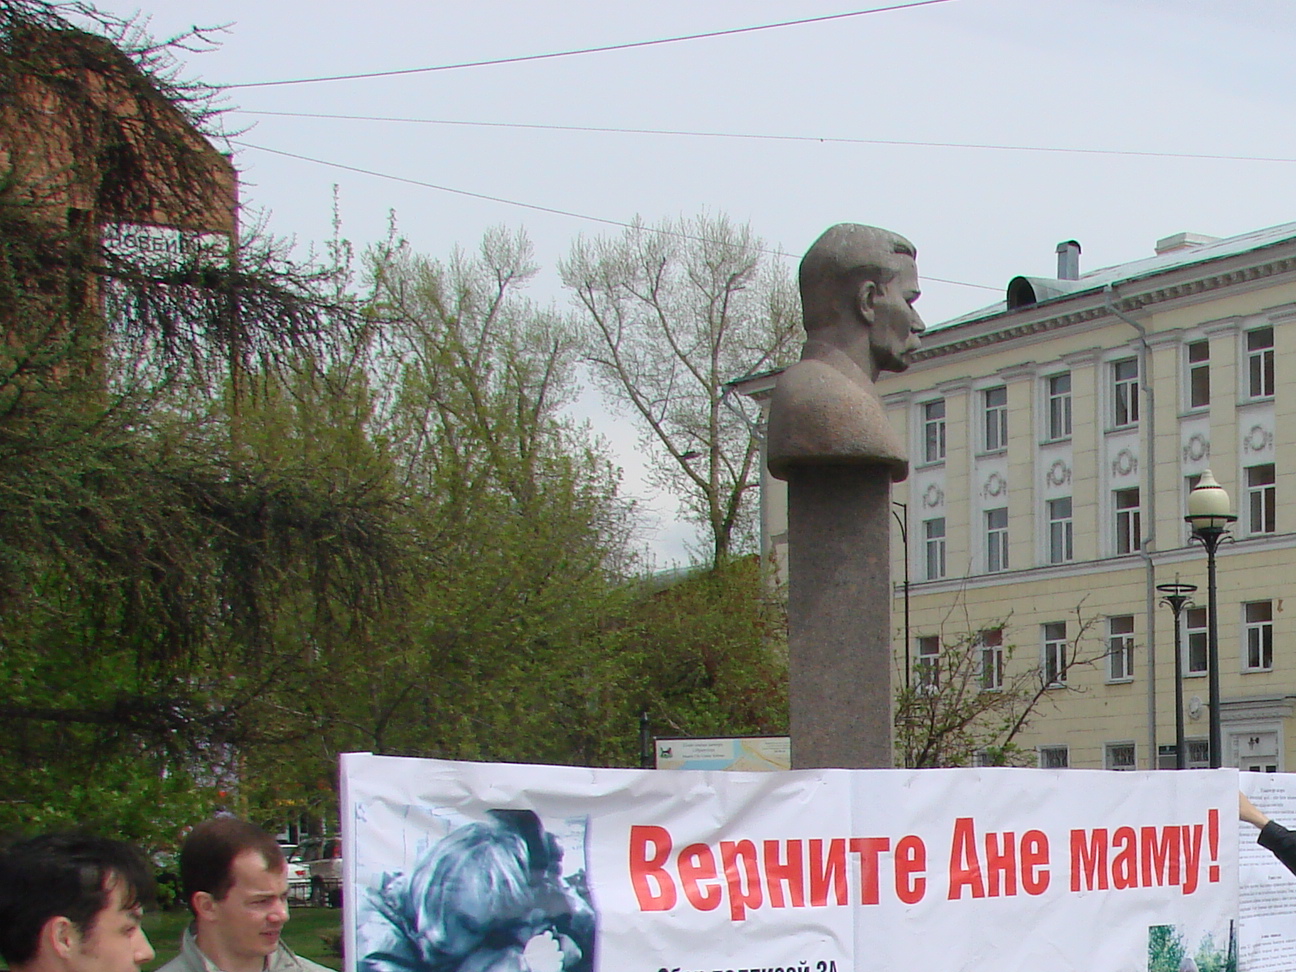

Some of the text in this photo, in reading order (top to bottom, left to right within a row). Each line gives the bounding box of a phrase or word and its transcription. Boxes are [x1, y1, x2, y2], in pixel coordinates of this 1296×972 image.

[629, 824, 927, 922] Верните
[947, 817, 1051, 901] Ане
[1070, 808, 1220, 895] маму!
